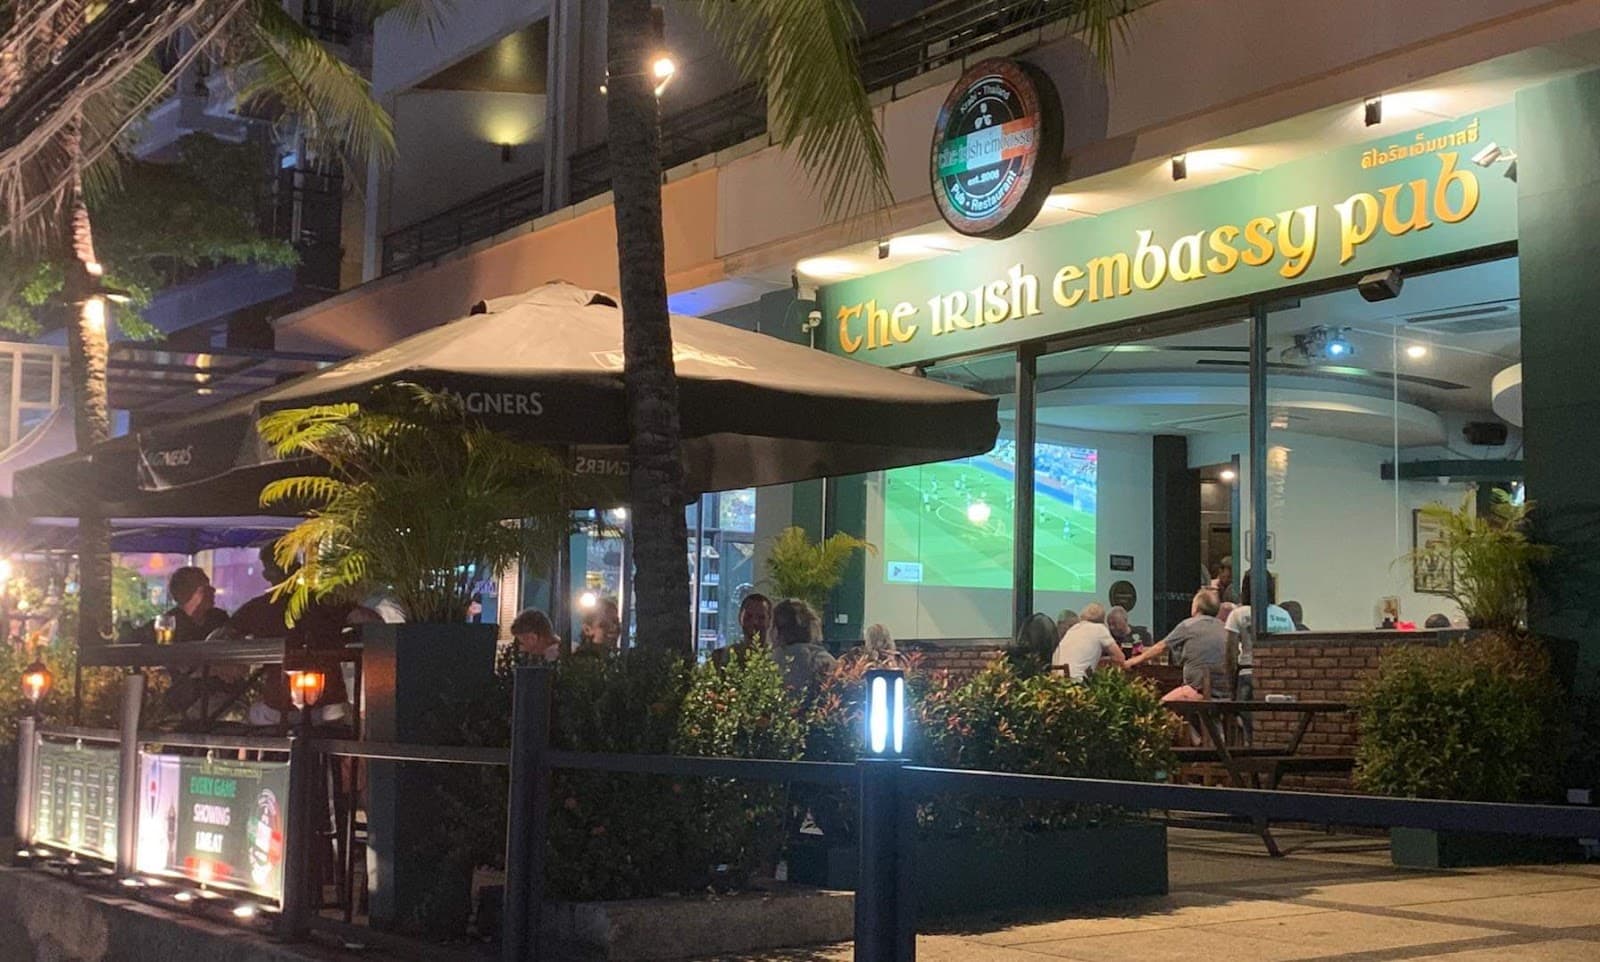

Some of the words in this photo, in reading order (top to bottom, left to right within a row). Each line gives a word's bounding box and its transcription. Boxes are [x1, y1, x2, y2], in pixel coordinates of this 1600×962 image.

[950, 185, 966, 206] Pub
[971, 170, 1017, 211] Restaurant
[837, 299, 920, 354] The
[1052, 204, 1319, 279] embassy
[1333, 152, 1480, 265] pub
[190, 776, 213, 796] EVERY
[193, 803, 231, 827] SHOWING
